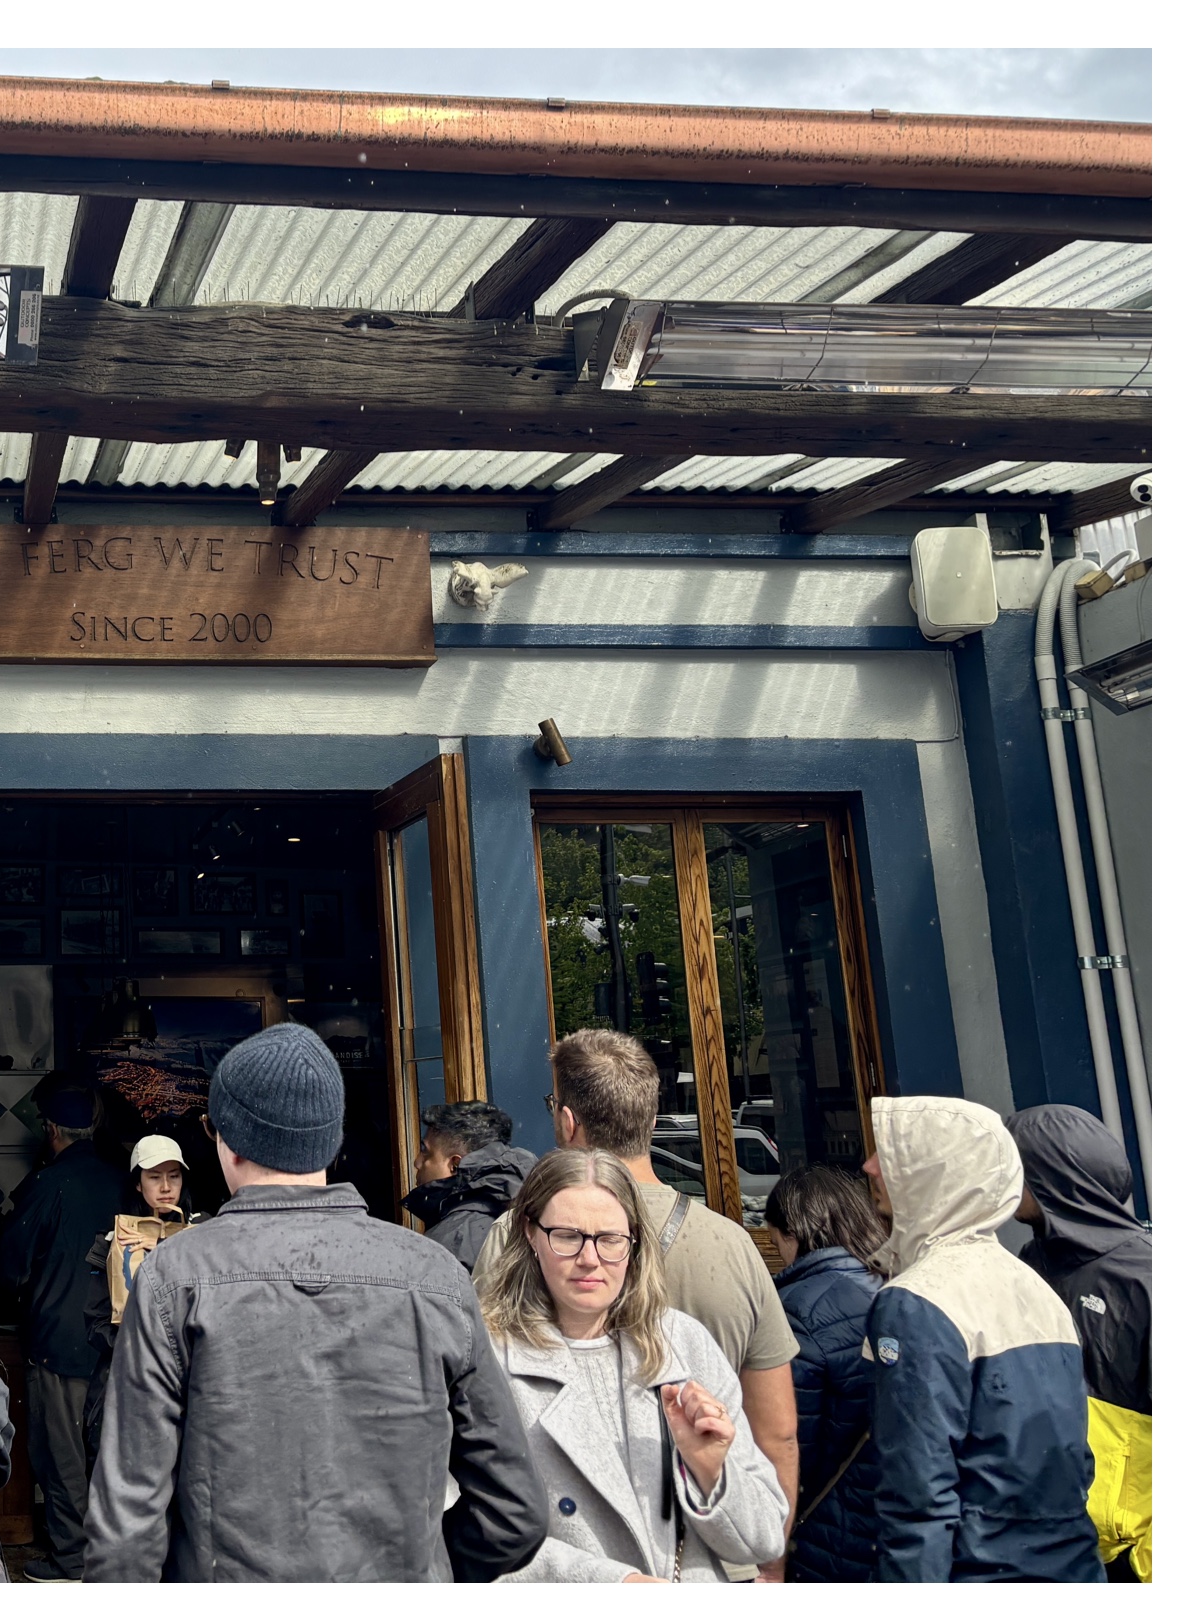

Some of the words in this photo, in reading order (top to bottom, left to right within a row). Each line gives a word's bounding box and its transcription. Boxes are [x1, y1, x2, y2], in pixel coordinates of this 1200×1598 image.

[21, 536, 133, 577] FERG
[153, 536, 225, 572] WE
[244, 539, 395, 590] TRUST
[69, 611, 175, 643] SINCE
[188, 612, 273, 644] 2000
